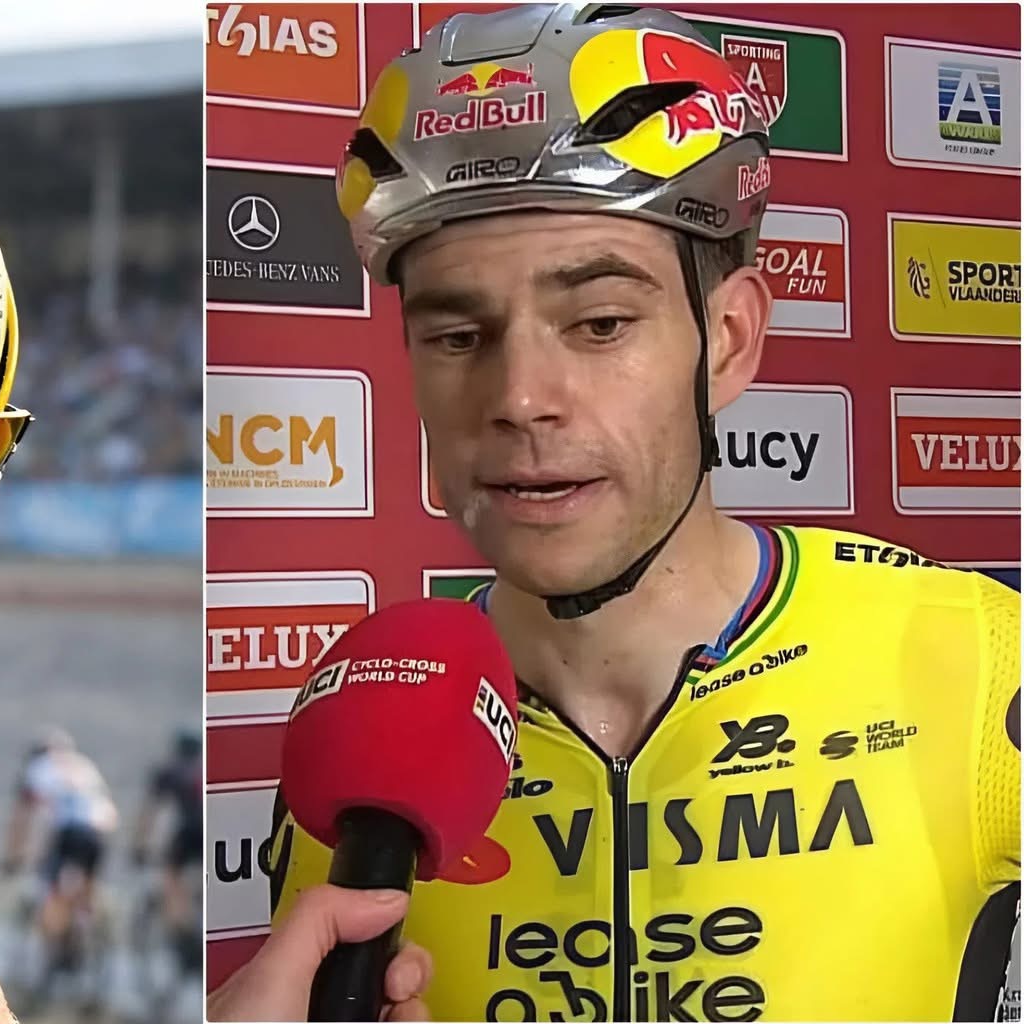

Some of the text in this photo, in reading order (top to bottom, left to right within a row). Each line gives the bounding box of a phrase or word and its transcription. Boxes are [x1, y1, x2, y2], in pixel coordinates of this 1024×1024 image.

[414, 92, 545, 141] Red Bull
[446, 157, 521, 184] GIRO
[787, 278, 826, 294] FUN
[206, 414, 343, 482] NCM
[719, 430, 820, 482] ucy
[398, 671, 427, 685] CUP
[484, 692, 517, 756] UCI
[531, 778, 875, 878] VISMA
